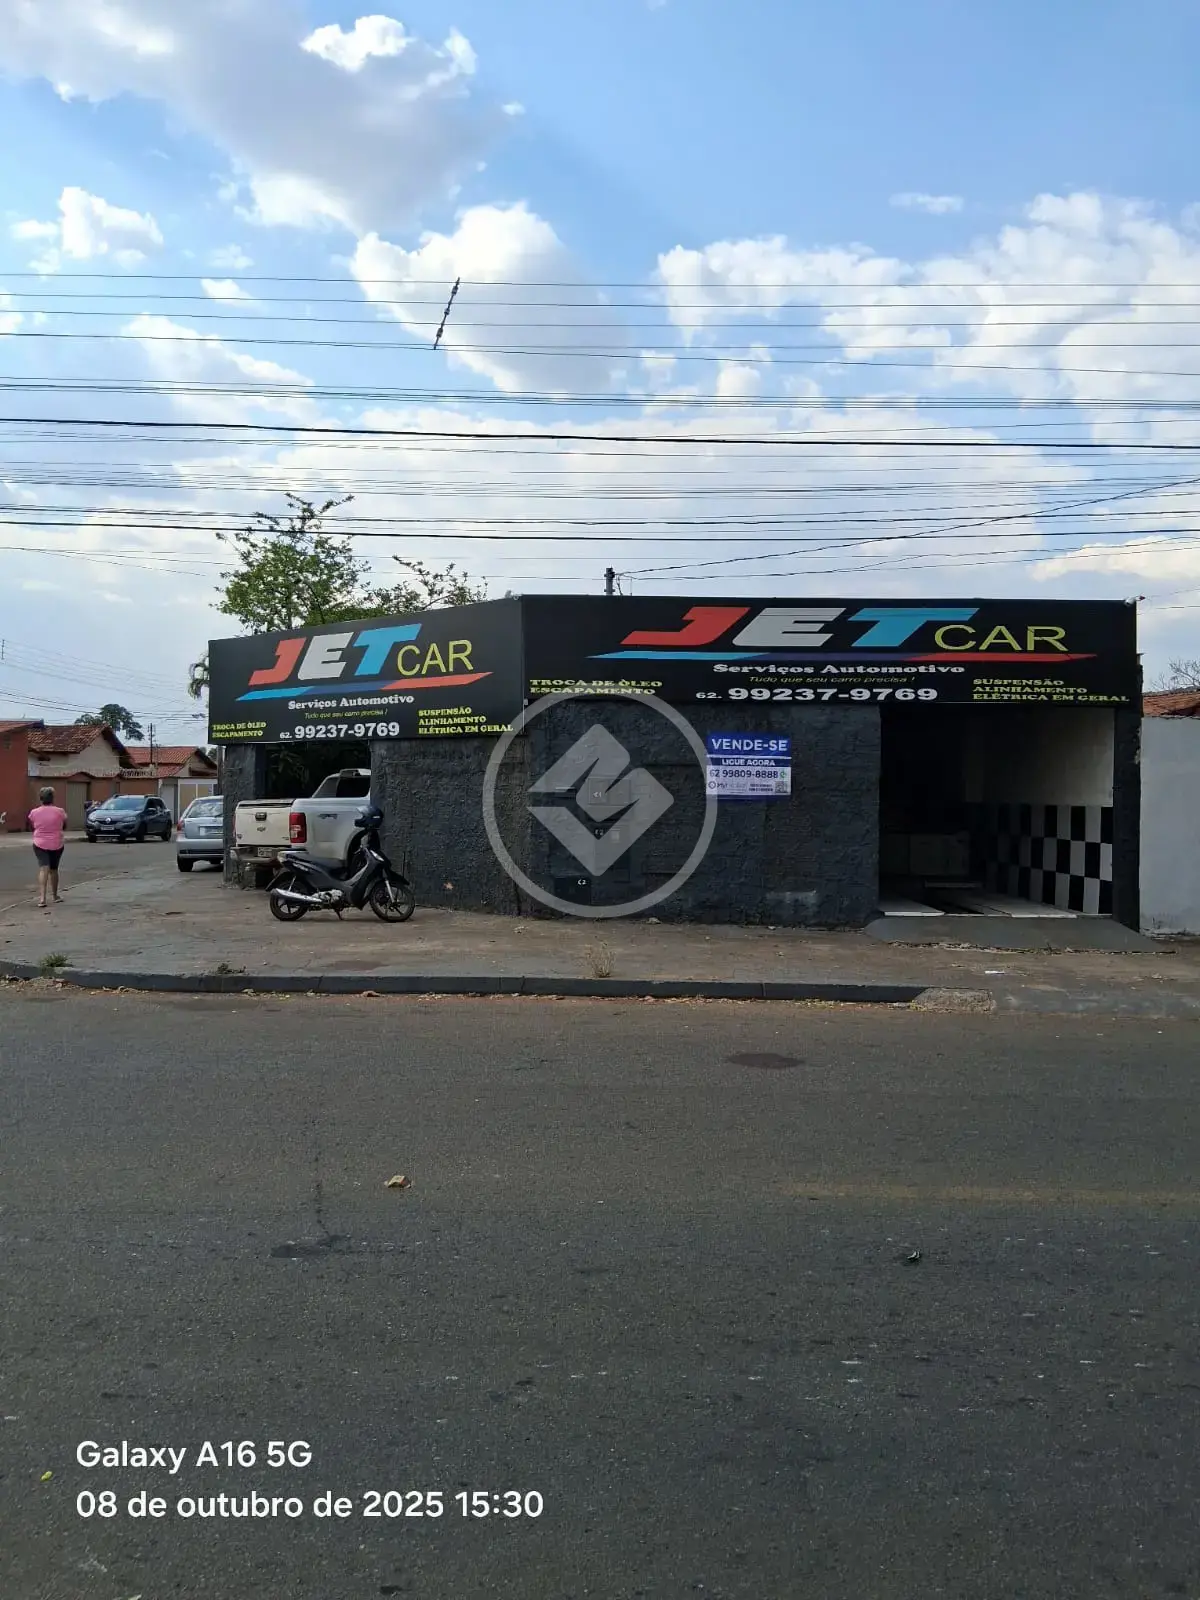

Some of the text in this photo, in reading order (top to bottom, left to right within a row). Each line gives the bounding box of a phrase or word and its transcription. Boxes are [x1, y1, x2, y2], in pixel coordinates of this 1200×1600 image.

[620, 606, 1069, 651] JET CAR
[248, 623, 474, 686] JET CAR
[713, 664, 965, 675] Serviços Automotivo
[530, 687, 656, 695] ESCAPAMENTO
[728, 687, 938, 701] 99237-9769
[973, 686, 1087, 694] ALINHAMENTO
[288, 694, 415, 710] Serviços Automotivo
[1052, 693, 1074, 701] EM
[1077, 694, 1130, 702] GERAL
[418, 706, 472, 717] SUSPENSÃO
[419, 715, 486, 726] ALINHAMENTO
[212, 730, 264, 738] ESCAPAMENTO
[294, 721, 400, 739] 99237-9769
[419, 724, 513, 735] ELÉTRICA EM GERAL
[711, 738, 788, 752] VENDE-SE
[721, 758, 746, 766] LIGUE
[722, 769, 779, 779] 99809-8888
